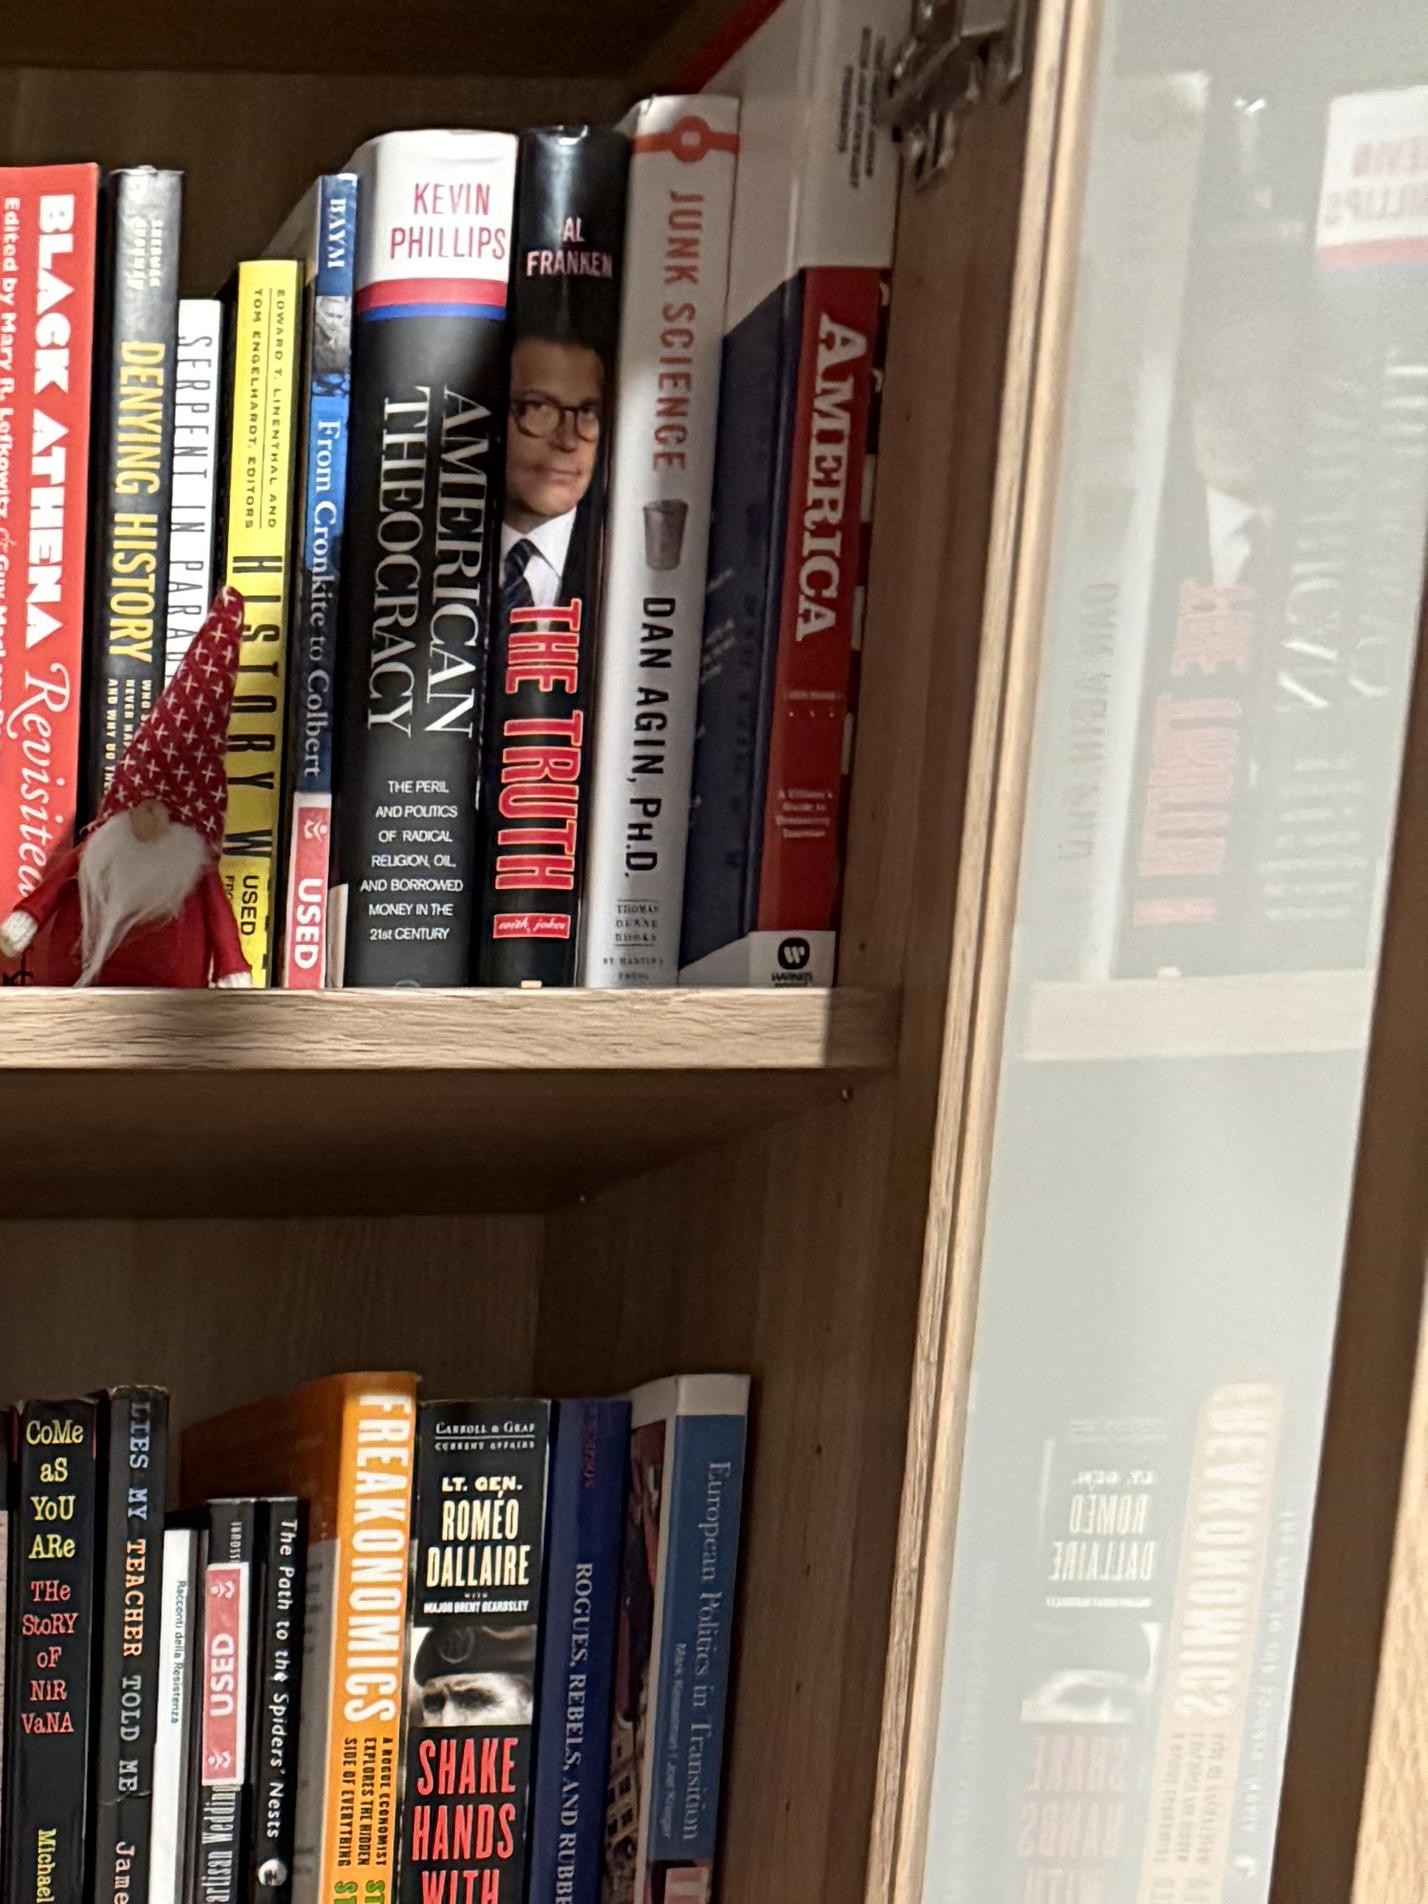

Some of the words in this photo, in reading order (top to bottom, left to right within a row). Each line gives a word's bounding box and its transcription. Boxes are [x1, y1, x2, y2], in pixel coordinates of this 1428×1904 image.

[389, 225, 507, 261] PHILLIPS
[412, 182, 491, 217] KEVIN
[562, 217, 585, 244] AL
[661, 189, 704, 286] JUNK
[31, 191, 76, 401] BLACK
[525, 249, 614, 280] FRANKEN
[114, 339, 166, 496] DENYING
[657, 297, 699, 472] SCIENCE
[795, 311, 870, 644] AMERICA
[22, 418, 72, 651] ATHENA
[365, 384, 431, 740] THEOCRACY
[424, 384, 497, 740] AMERICAN
[107, 515, 160, 665] HISTORY
[506, 596, 582, 695] THE
[494, 713, 582, 892] TRUTH
[293, 879, 320, 971] USED
[345, 1394, 414, 1725] FREAKONOMICS
[441, 1486, 519, 1543] ROMÉO
[426, 1543, 531, 1590] DALLAIRE
[417, 1736, 519, 1797] SHAKE
[410, 1802, 515, 1862] HANDS
